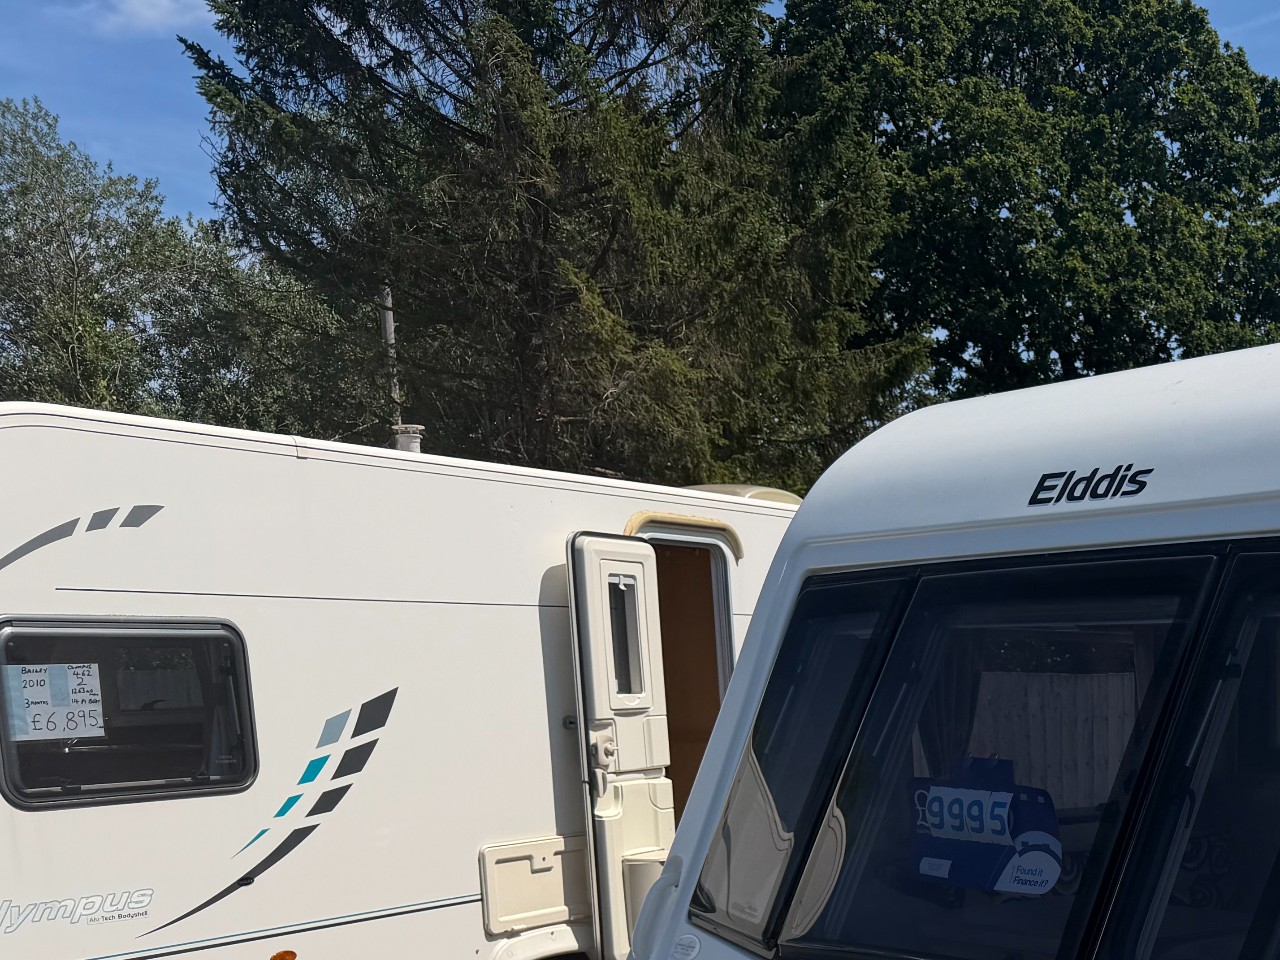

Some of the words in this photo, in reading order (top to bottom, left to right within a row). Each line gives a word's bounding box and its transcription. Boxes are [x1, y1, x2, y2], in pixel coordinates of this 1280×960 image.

[1027, 463, 1155, 506] Elddis
[22, 679, 46, 689] 2010
[76, 676, 87, 686] 2
[24, 698, 31, 708] 3
[1016, 865, 1037, 876] Found
[1037, 868, 1043, 877] it
[1013, 875, 1038, 887] Finance
[1038, 879, 1049, 888] it?
[117, 910, 149, 920] Bodyshell
